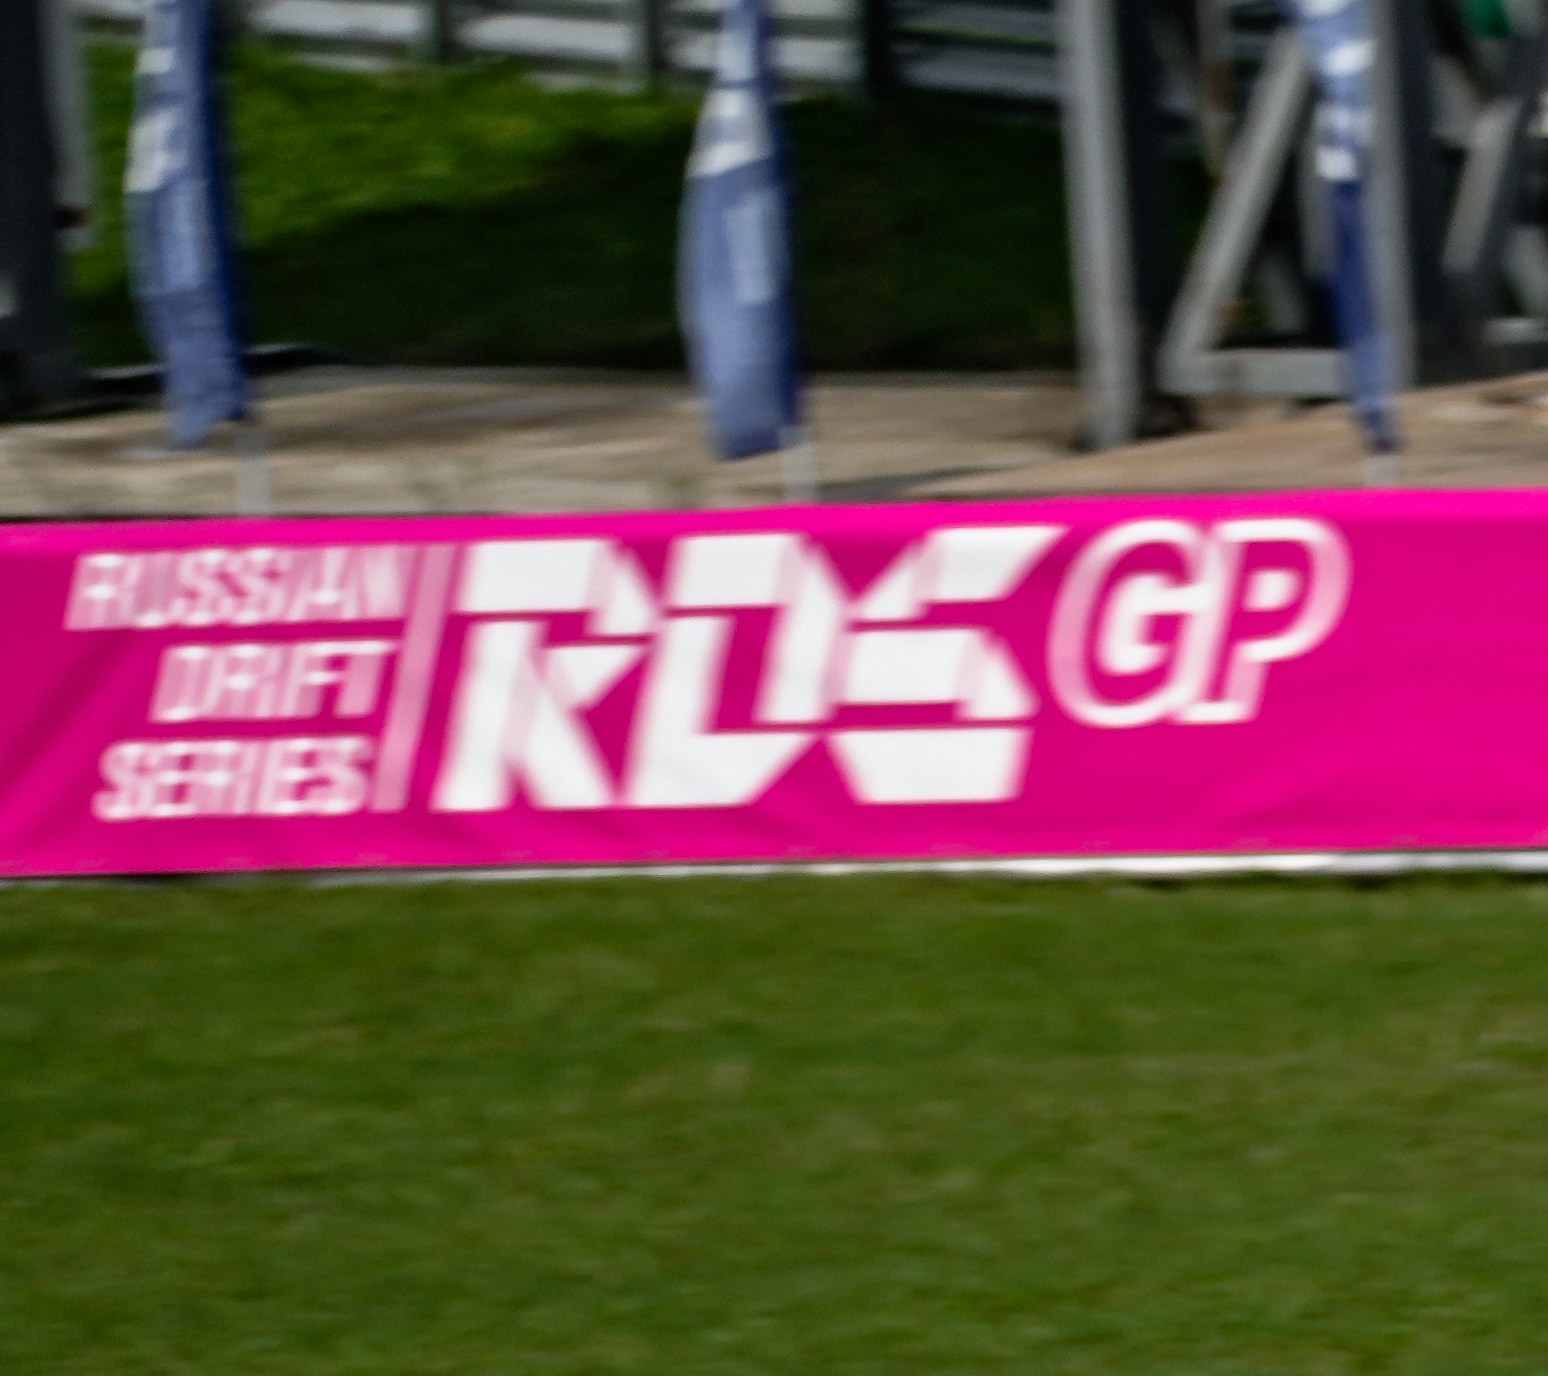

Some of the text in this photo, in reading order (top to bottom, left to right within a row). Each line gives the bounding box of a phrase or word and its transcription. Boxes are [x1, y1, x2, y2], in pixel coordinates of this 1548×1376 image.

[65, 545, 414, 631] RUSSIAN
[149, 638, 401, 723] DRIFT
[430, 518, 1352, 812] RDS GP
[91, 735, 373, 822] SERIES
